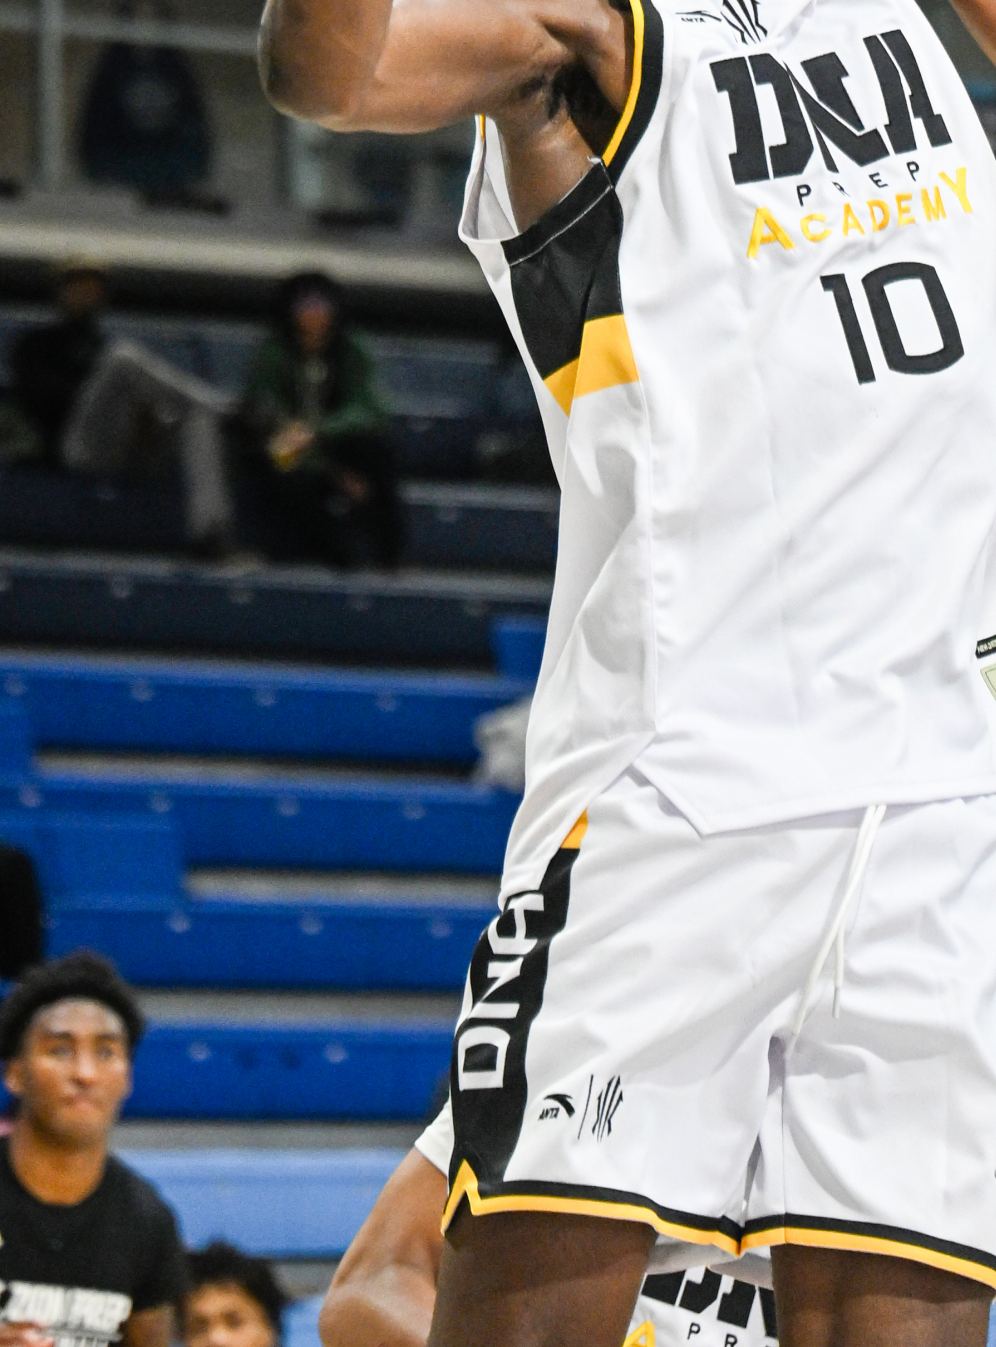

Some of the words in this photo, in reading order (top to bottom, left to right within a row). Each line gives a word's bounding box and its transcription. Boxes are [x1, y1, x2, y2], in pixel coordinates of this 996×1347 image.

[709, 29, 953, 185] DNA
[746, 167, 973, 258] ACADEMY
[796, 161, 920, 207] PREP
[820, 261, 965, 385] 10
